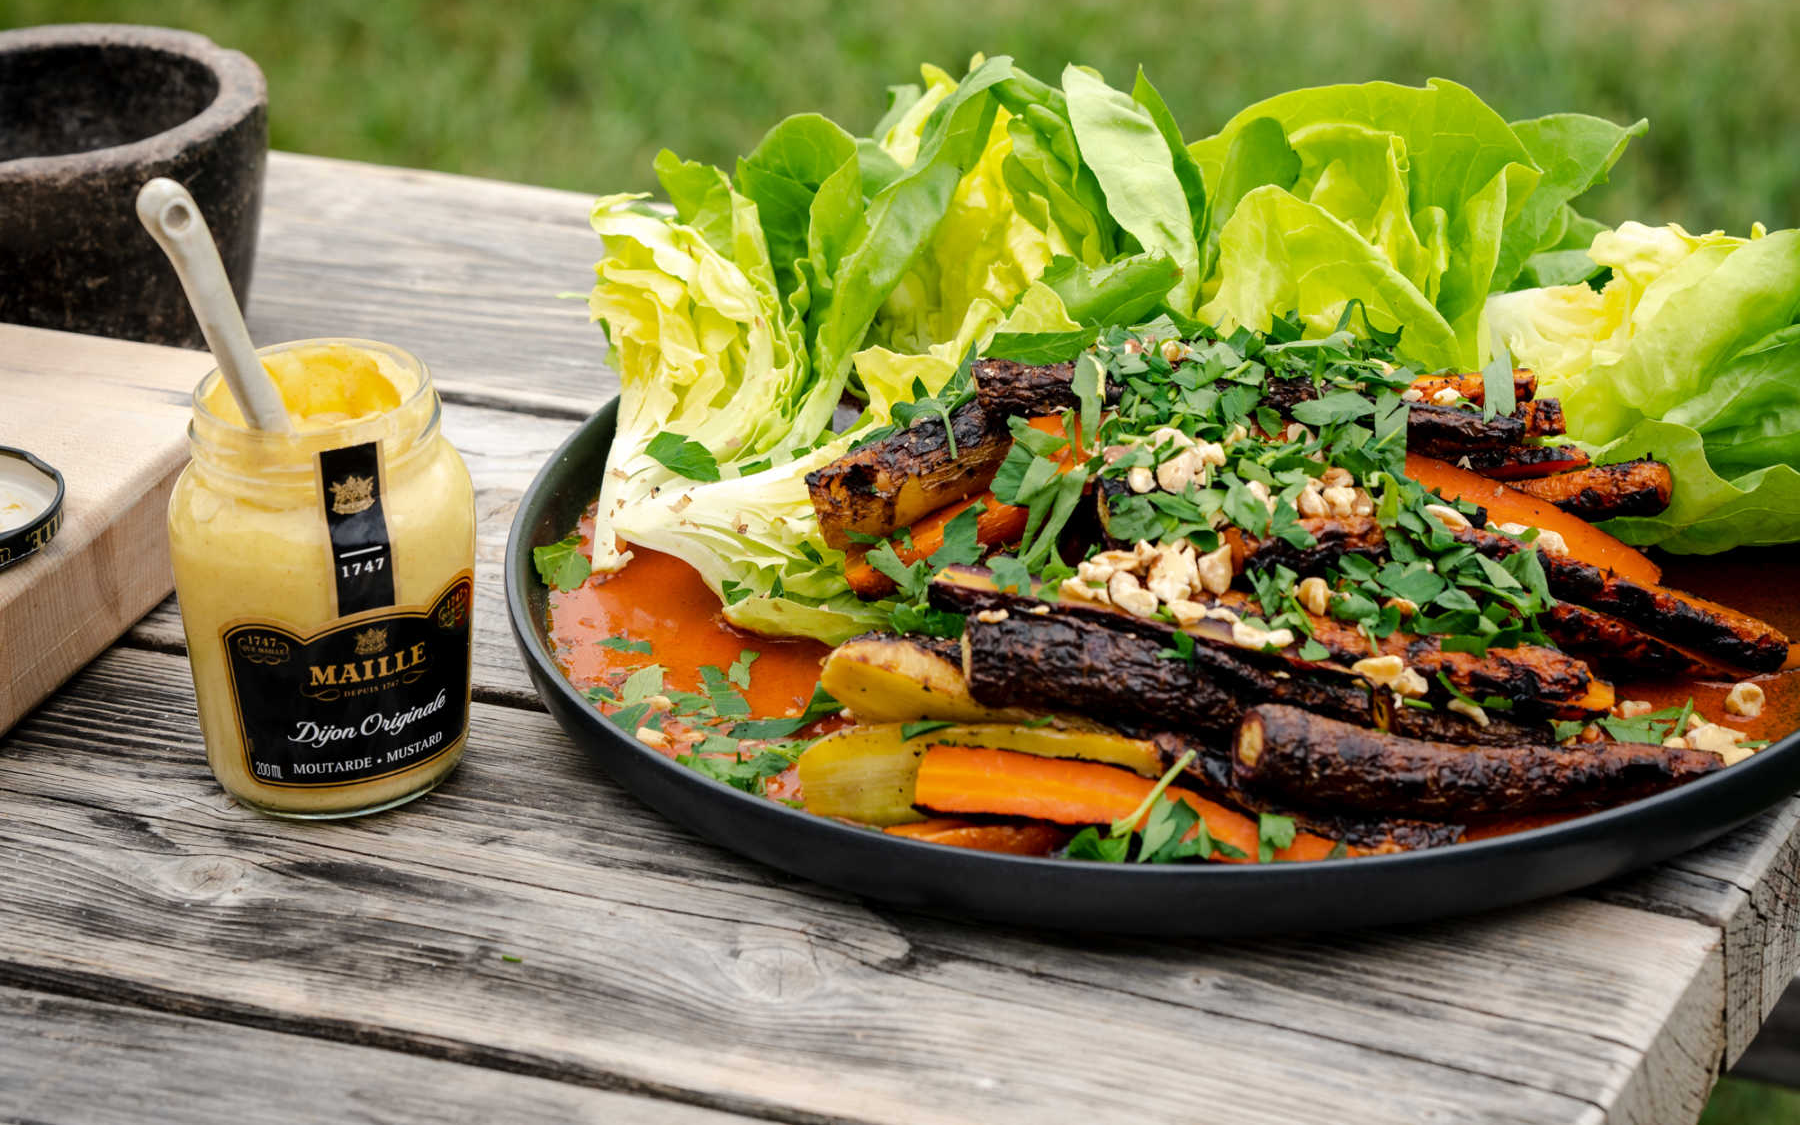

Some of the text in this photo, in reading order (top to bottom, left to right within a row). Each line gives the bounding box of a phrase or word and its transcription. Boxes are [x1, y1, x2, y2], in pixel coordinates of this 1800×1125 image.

[342, 557, 384, 578] 1747
[248, 635, 276, 647] 1747
[309, 641, 426, 686] MAILLE
[344, 686, 379, 698] DEPUIS
[287, 688, 446, 748] Dijon Originale
[293, 731, 443, 775] MOUTARDE MUSTARD
